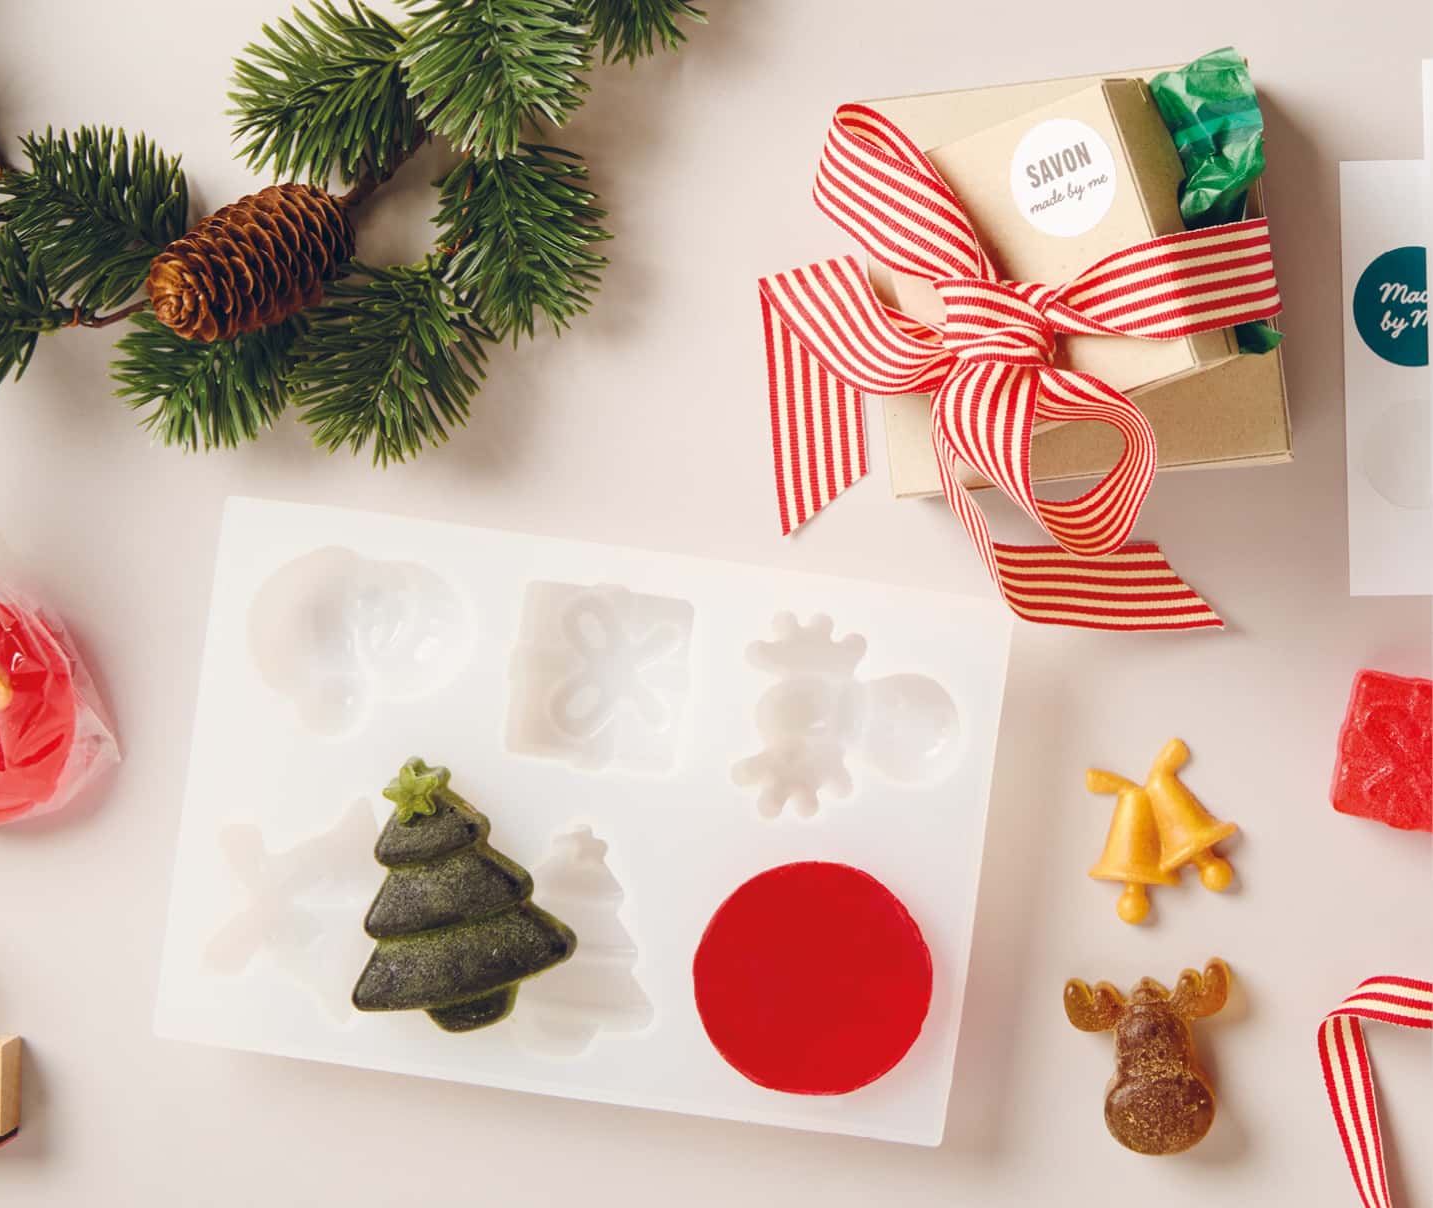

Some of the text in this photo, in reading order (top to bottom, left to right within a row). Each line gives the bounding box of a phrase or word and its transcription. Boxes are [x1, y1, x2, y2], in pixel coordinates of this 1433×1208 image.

[1026, 141, 1092, 188] SAVON
[1030, 174, 1108, 215] made by me
[1380, 309, 1409, 339] by
